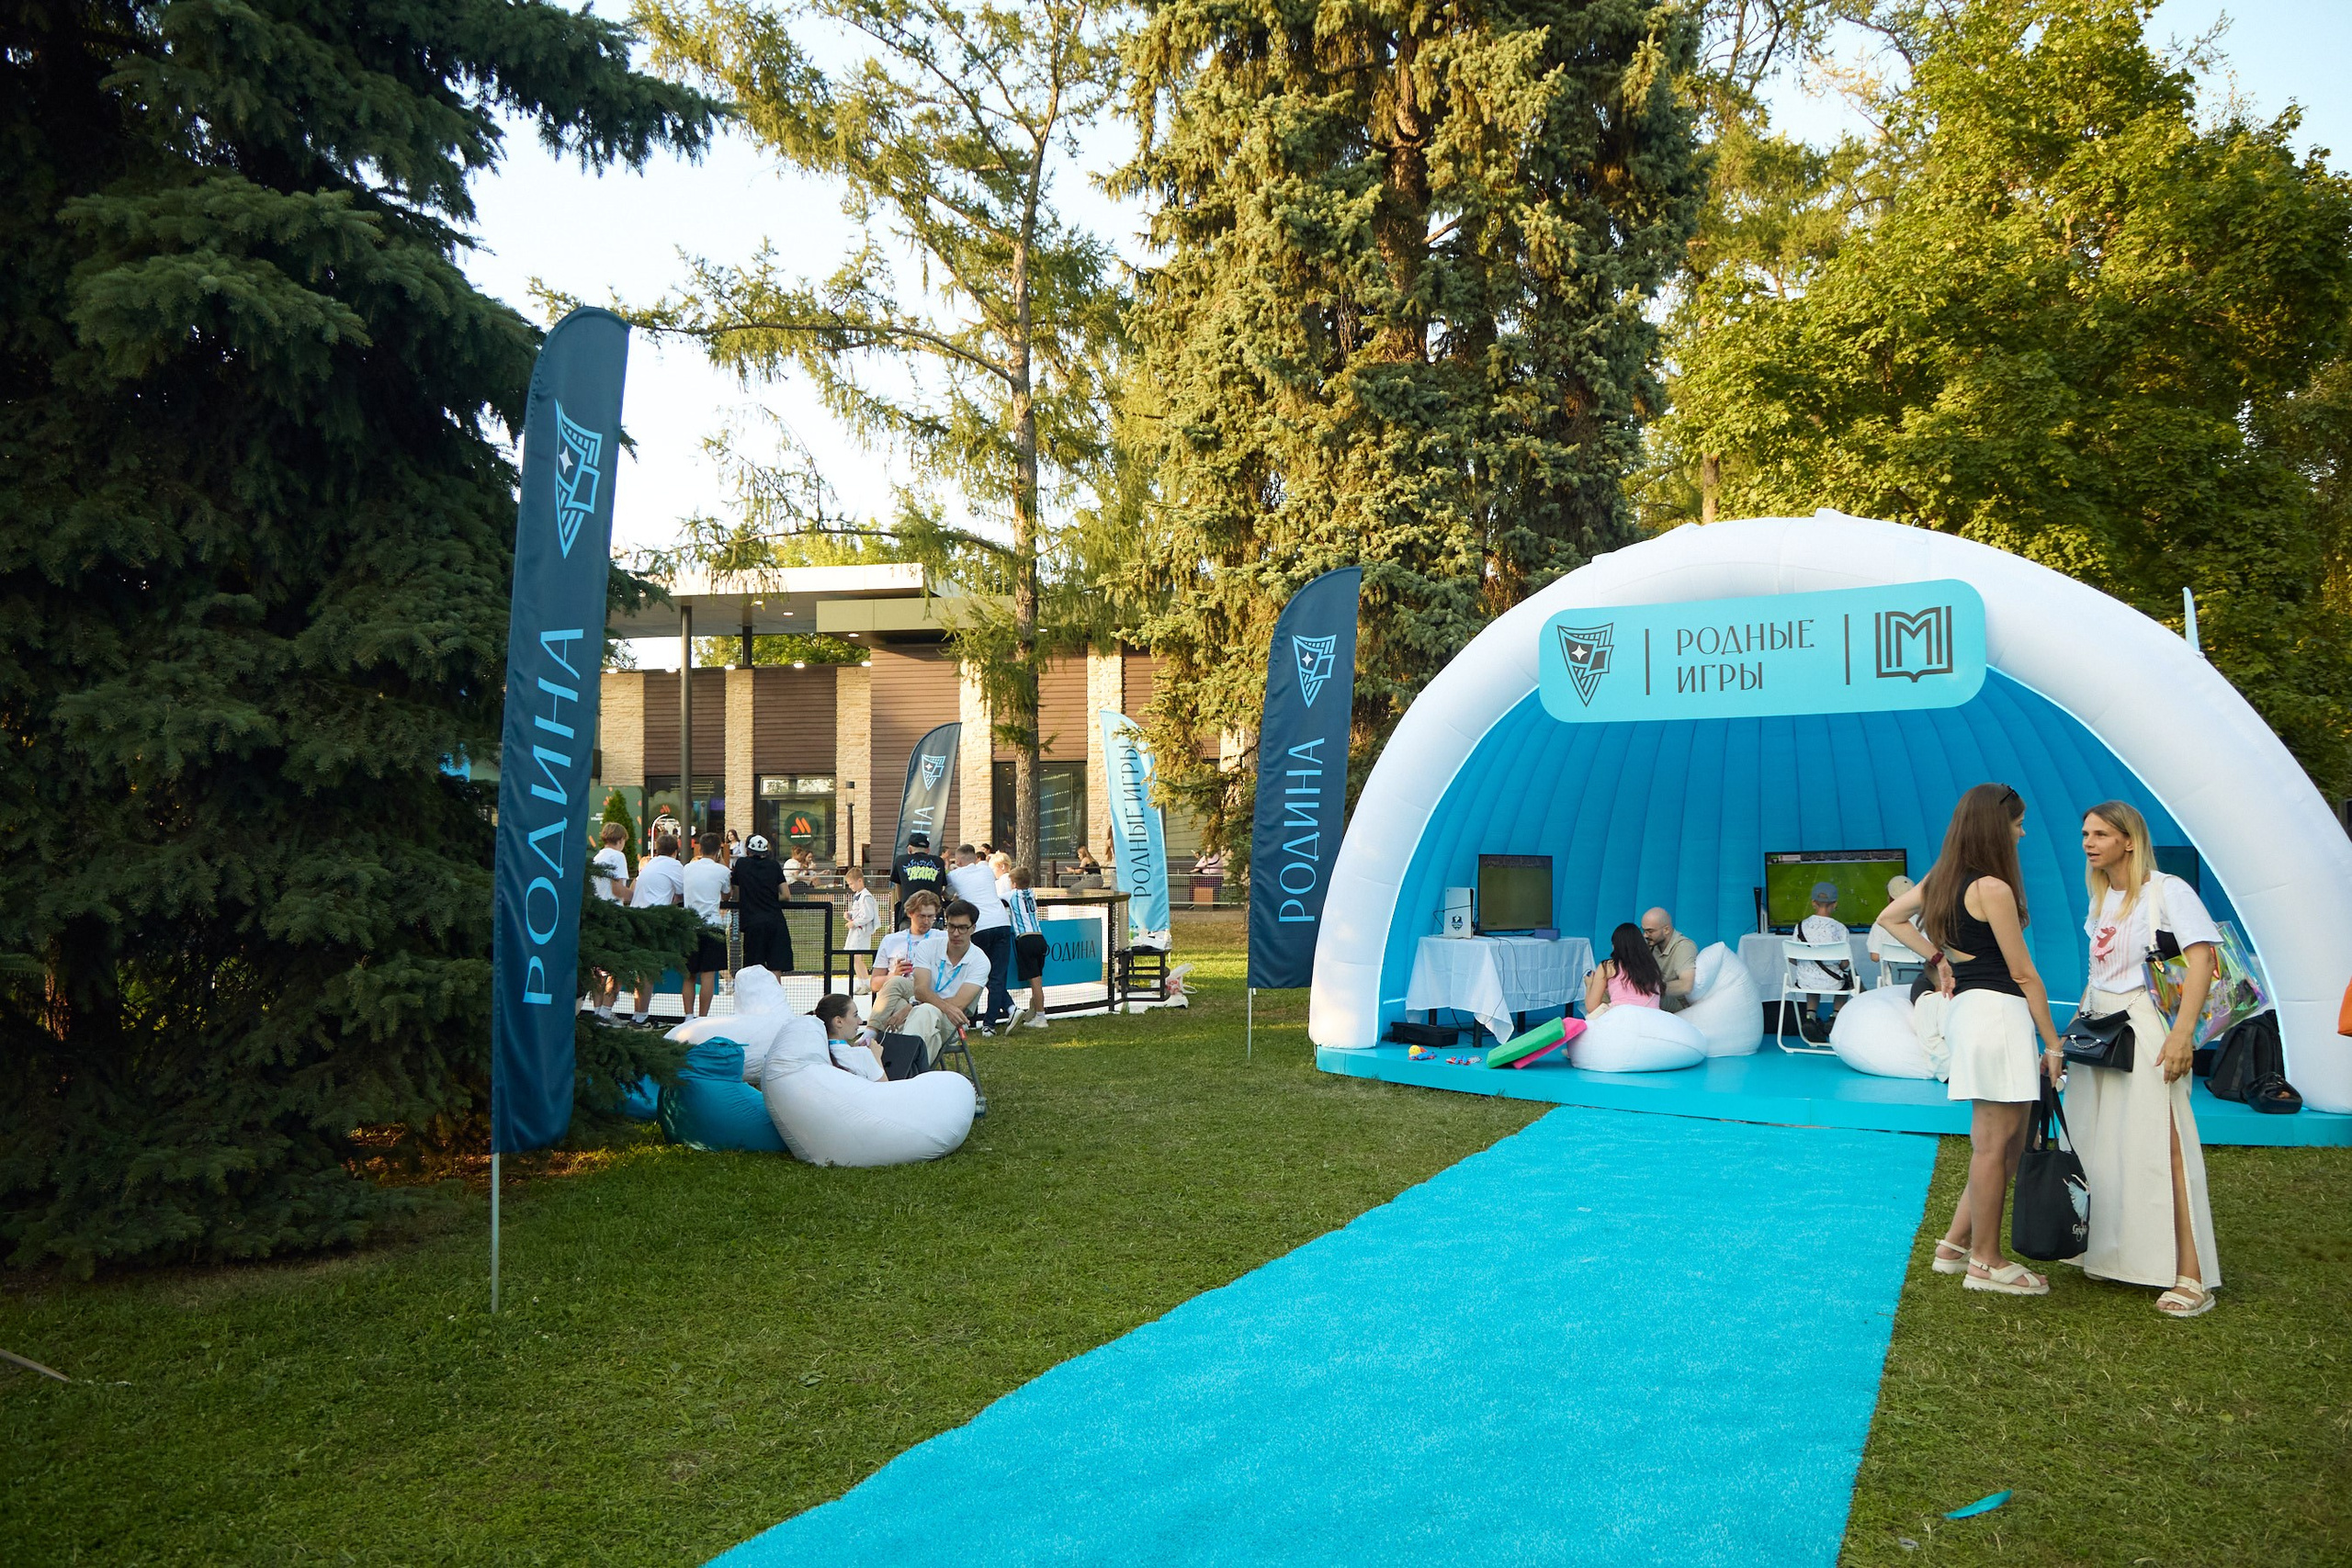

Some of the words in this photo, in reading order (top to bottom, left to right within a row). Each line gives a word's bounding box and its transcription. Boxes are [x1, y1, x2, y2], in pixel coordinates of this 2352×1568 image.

[1677, 619, 1815, 656] РОДНЫЕ
[1678, 661, 1763, 694] ИГРЫ
[1118, 745, 1143, 801] ИГРЫ
[524, 628, 583, 1004] РОДИНА
[1278, 737, 1325, 922] РОДИНА
[1125, 807, 1152, 897] РОДНЫЕ
[1022, 896, 1036, 913] 10
